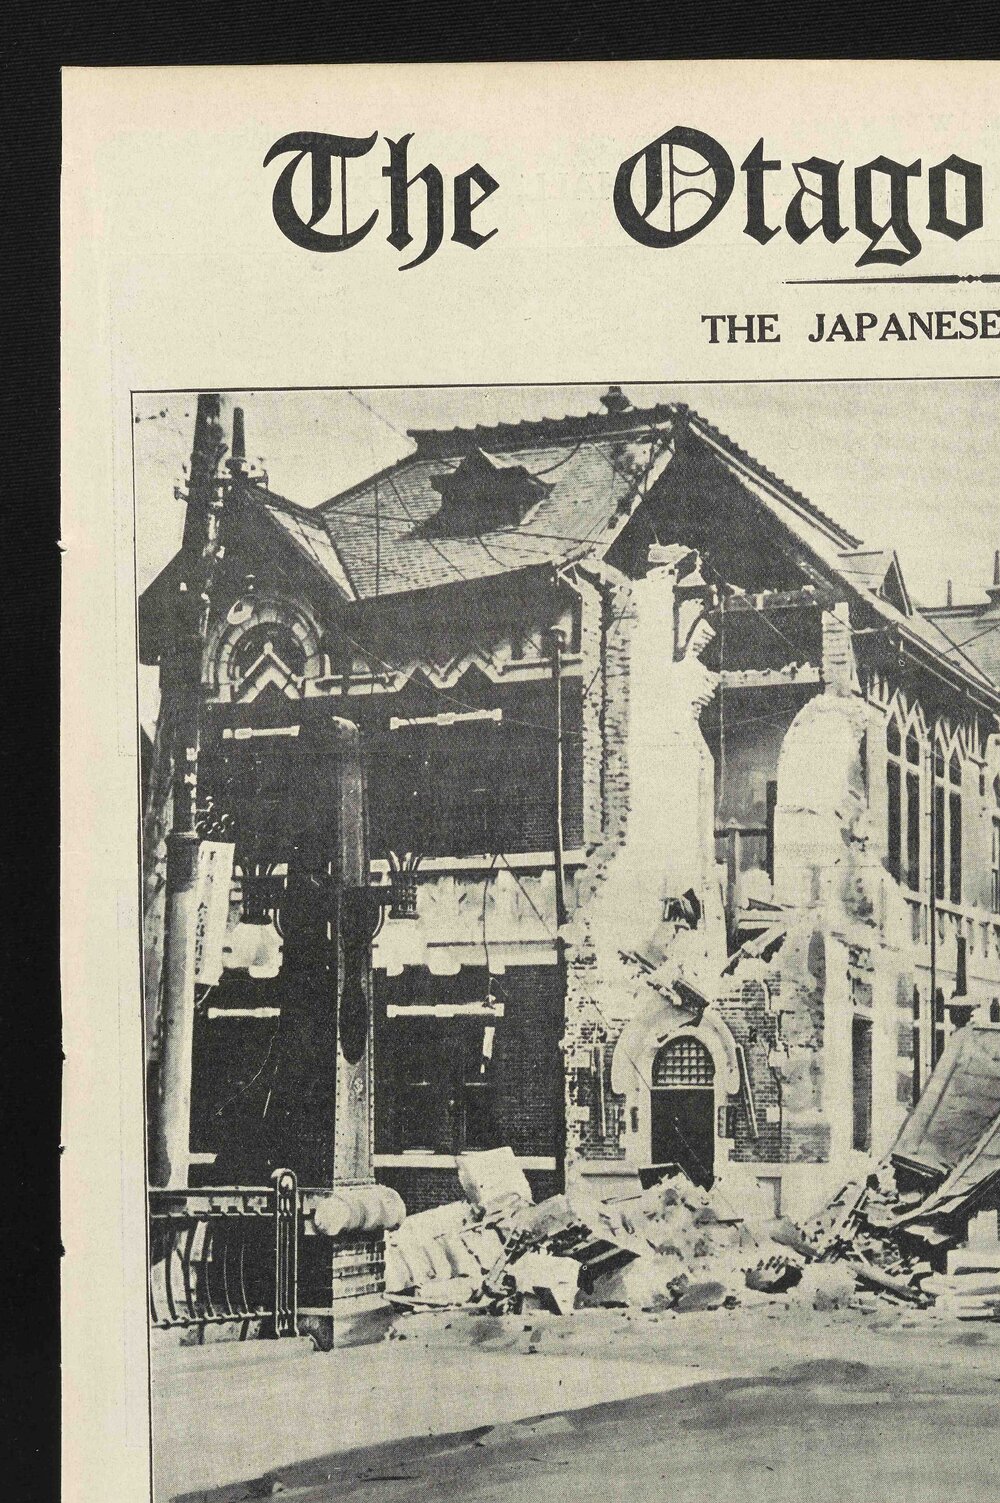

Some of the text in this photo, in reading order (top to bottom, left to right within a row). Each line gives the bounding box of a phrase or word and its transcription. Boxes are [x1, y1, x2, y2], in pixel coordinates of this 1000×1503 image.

[262, 130, 500, 272] The
[613, 126, 984, 268] Otago
[701, 314, 781, 345] THE
